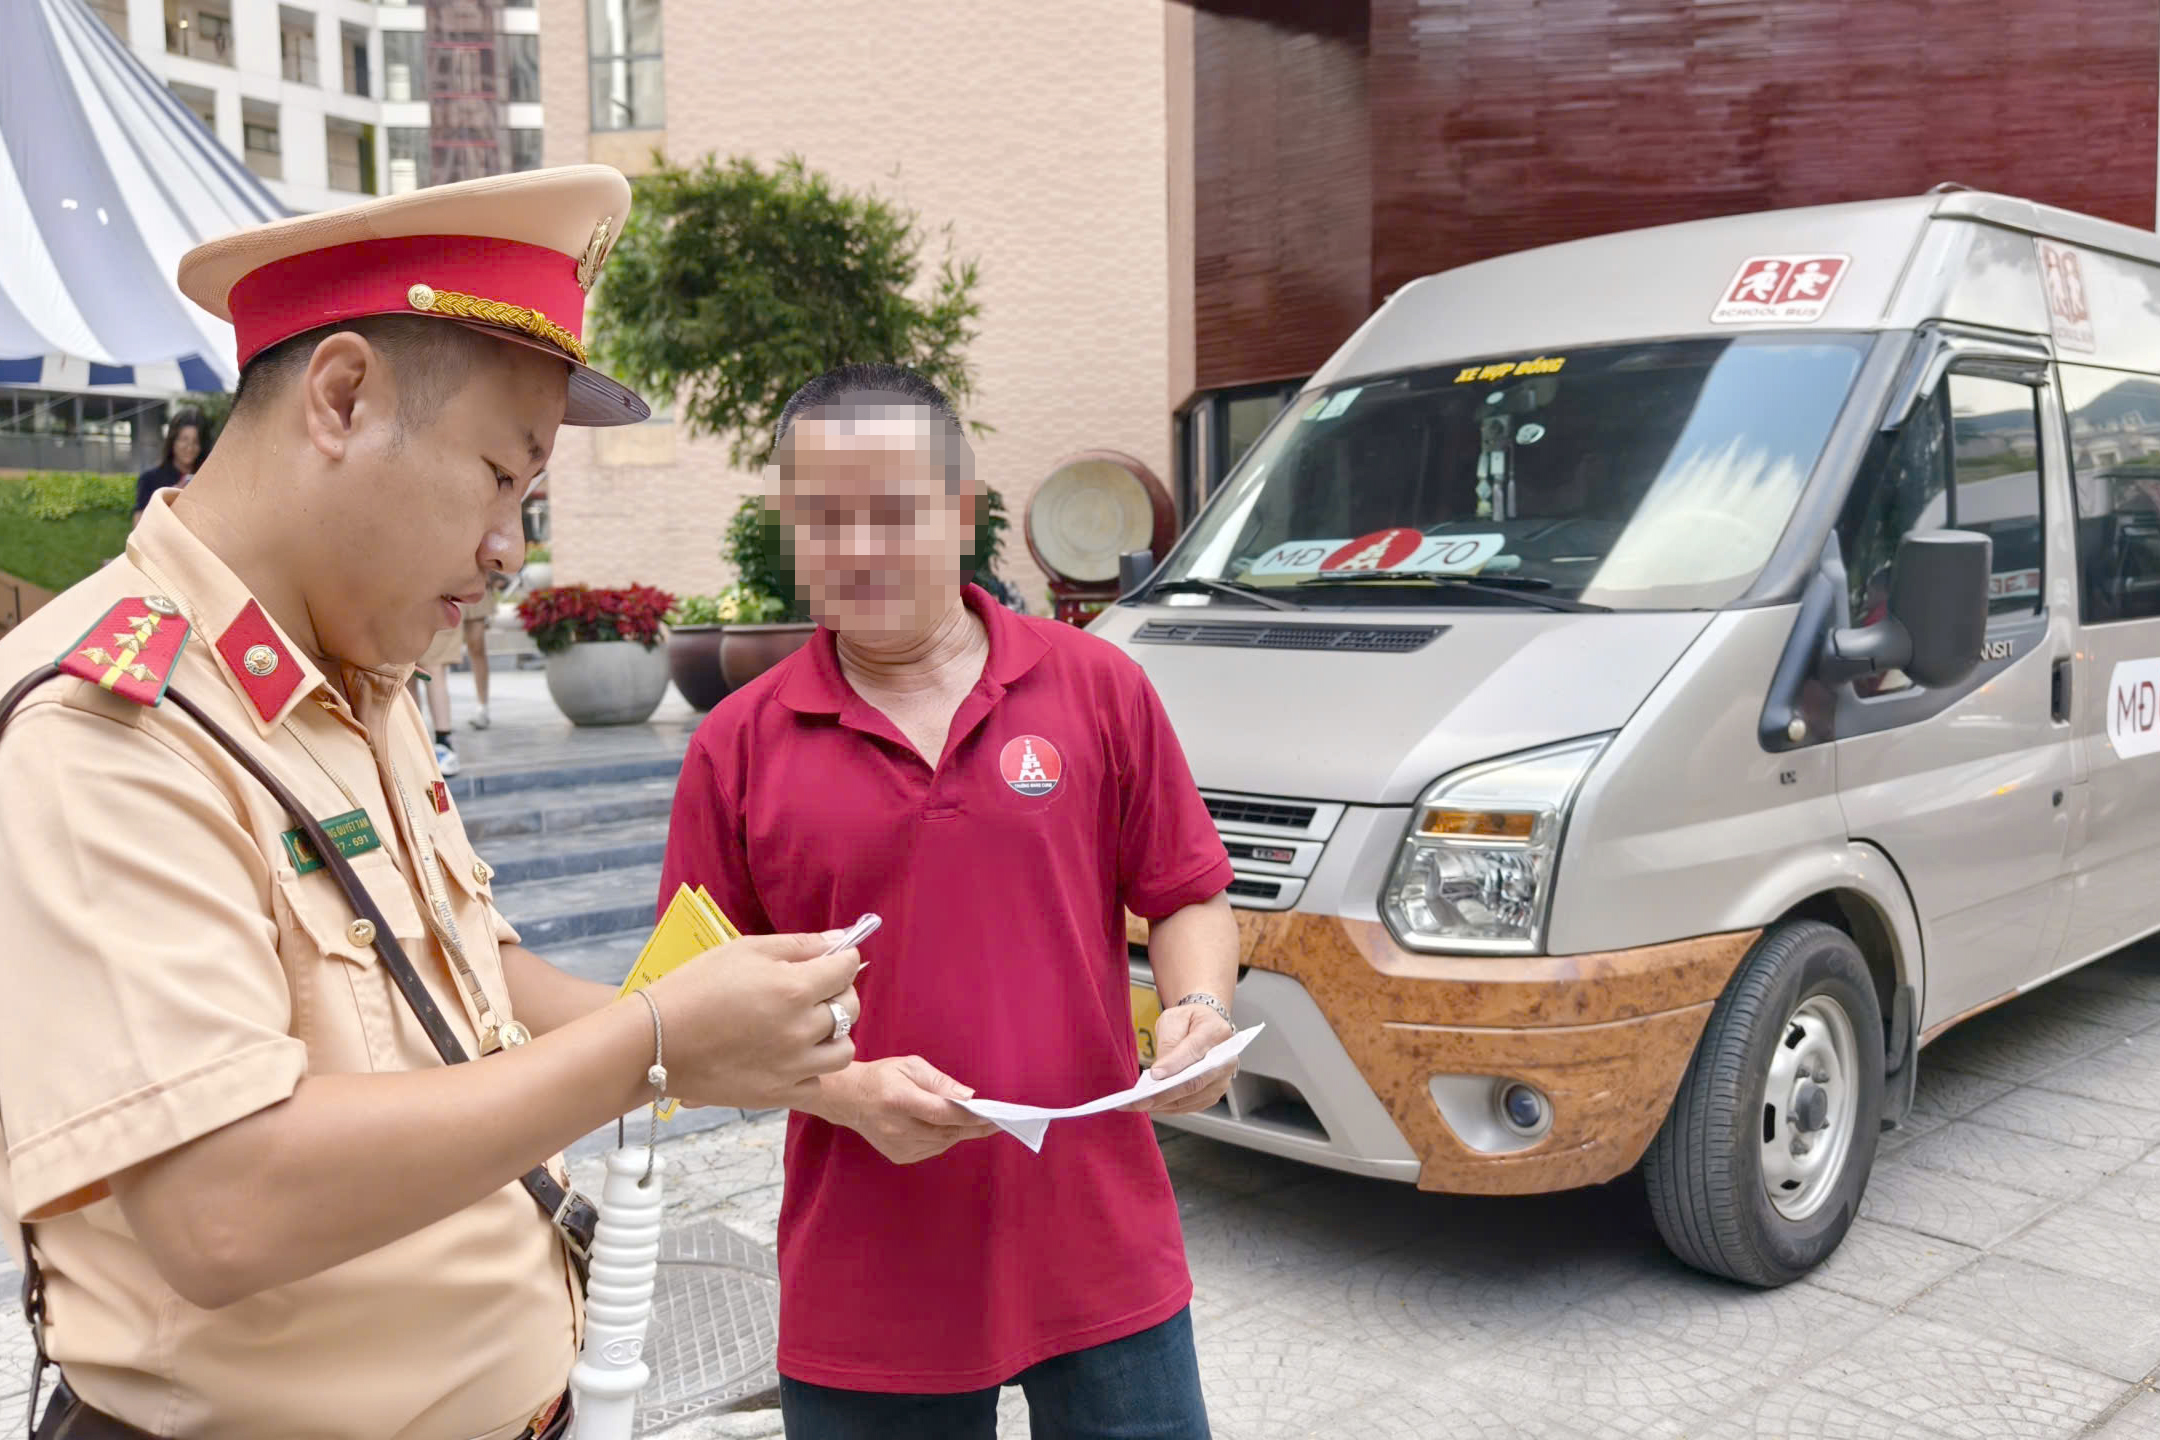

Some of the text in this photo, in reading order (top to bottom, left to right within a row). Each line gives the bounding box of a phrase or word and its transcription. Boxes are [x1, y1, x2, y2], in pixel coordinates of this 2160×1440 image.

[1718, 308, 1819, 317] SCHOOL BUS
[1453, 367, 1482, 383] XE
[1416, 540, 1480, 566] 70
